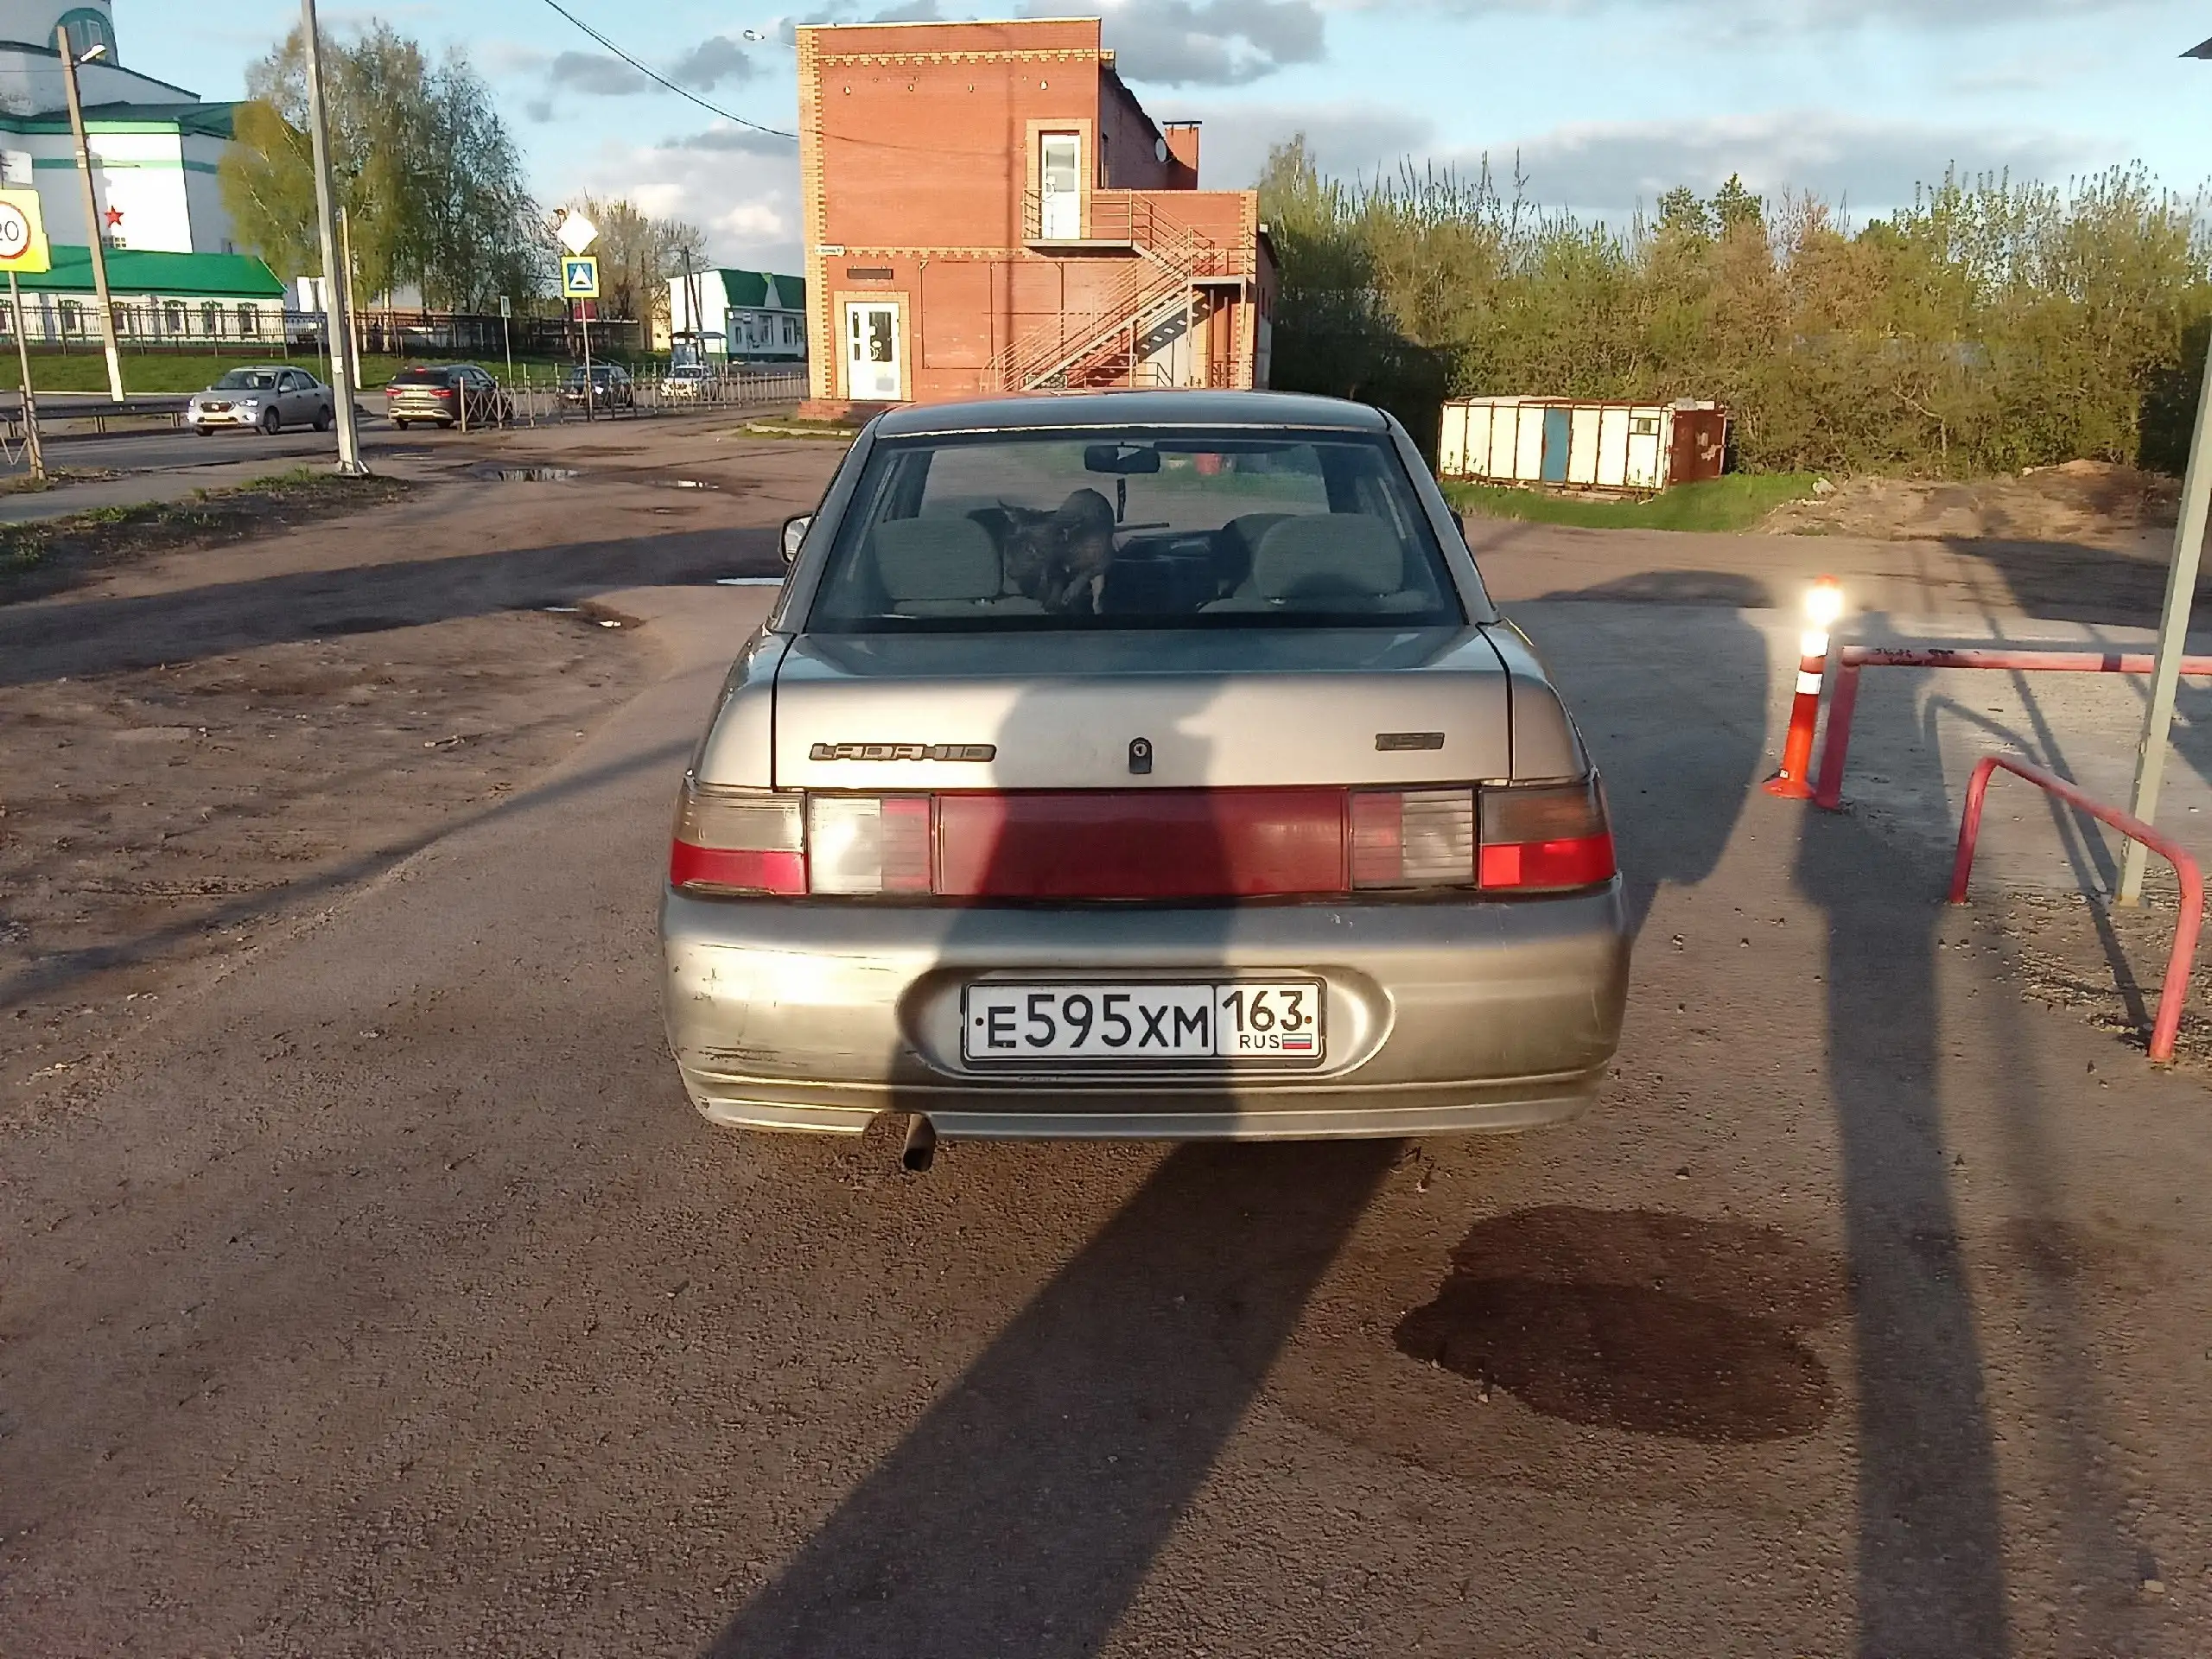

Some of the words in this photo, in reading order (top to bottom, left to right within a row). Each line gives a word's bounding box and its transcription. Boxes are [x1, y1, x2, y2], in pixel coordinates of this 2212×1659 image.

[0, 220, 19, 242] 0
[1222, 990, 1303, 1032] 163
[1239, 1034, 1280, 1049] RUS
